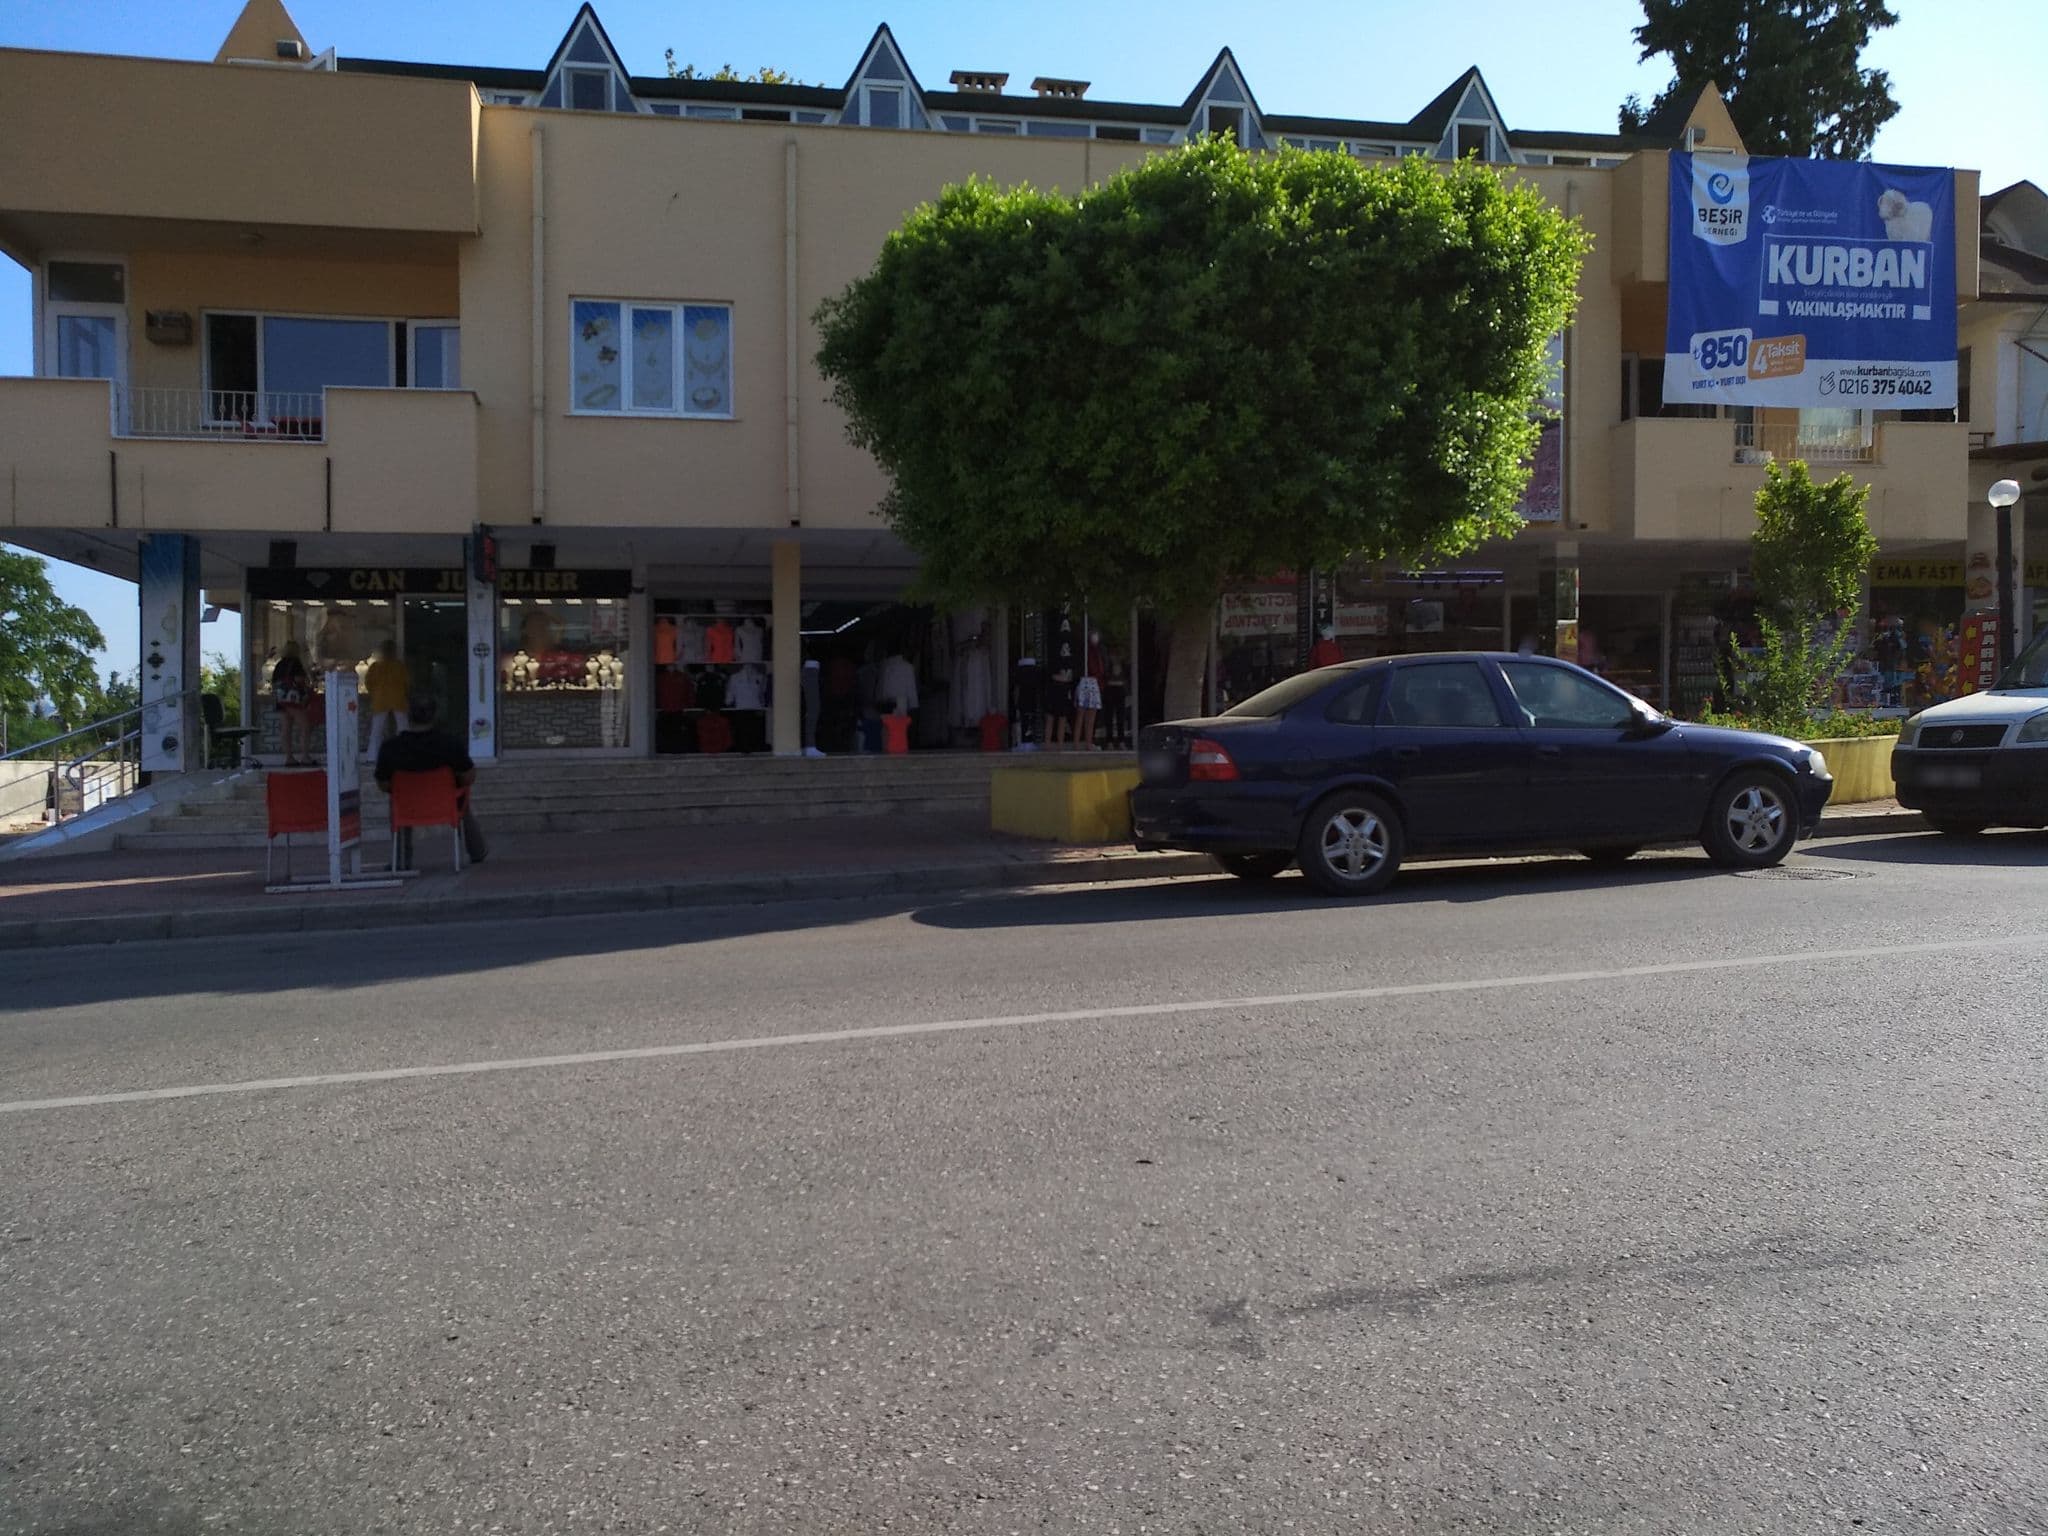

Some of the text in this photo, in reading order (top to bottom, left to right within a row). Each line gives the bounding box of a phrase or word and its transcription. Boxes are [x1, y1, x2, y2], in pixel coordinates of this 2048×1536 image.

[1768, 244, 1925, 288] KURBAN
[1787, 300, 1906, 320] YAKINLAŞMAKTIR
[1752, 344, 1768, 374] 4
[1766, 340, 1800, 359] Taksit
[1839, 380, 1932, 395] 0216 375 4042
[351, 570, 405, 591] CAN
[1978, 621, 1998, 690] MARKE
